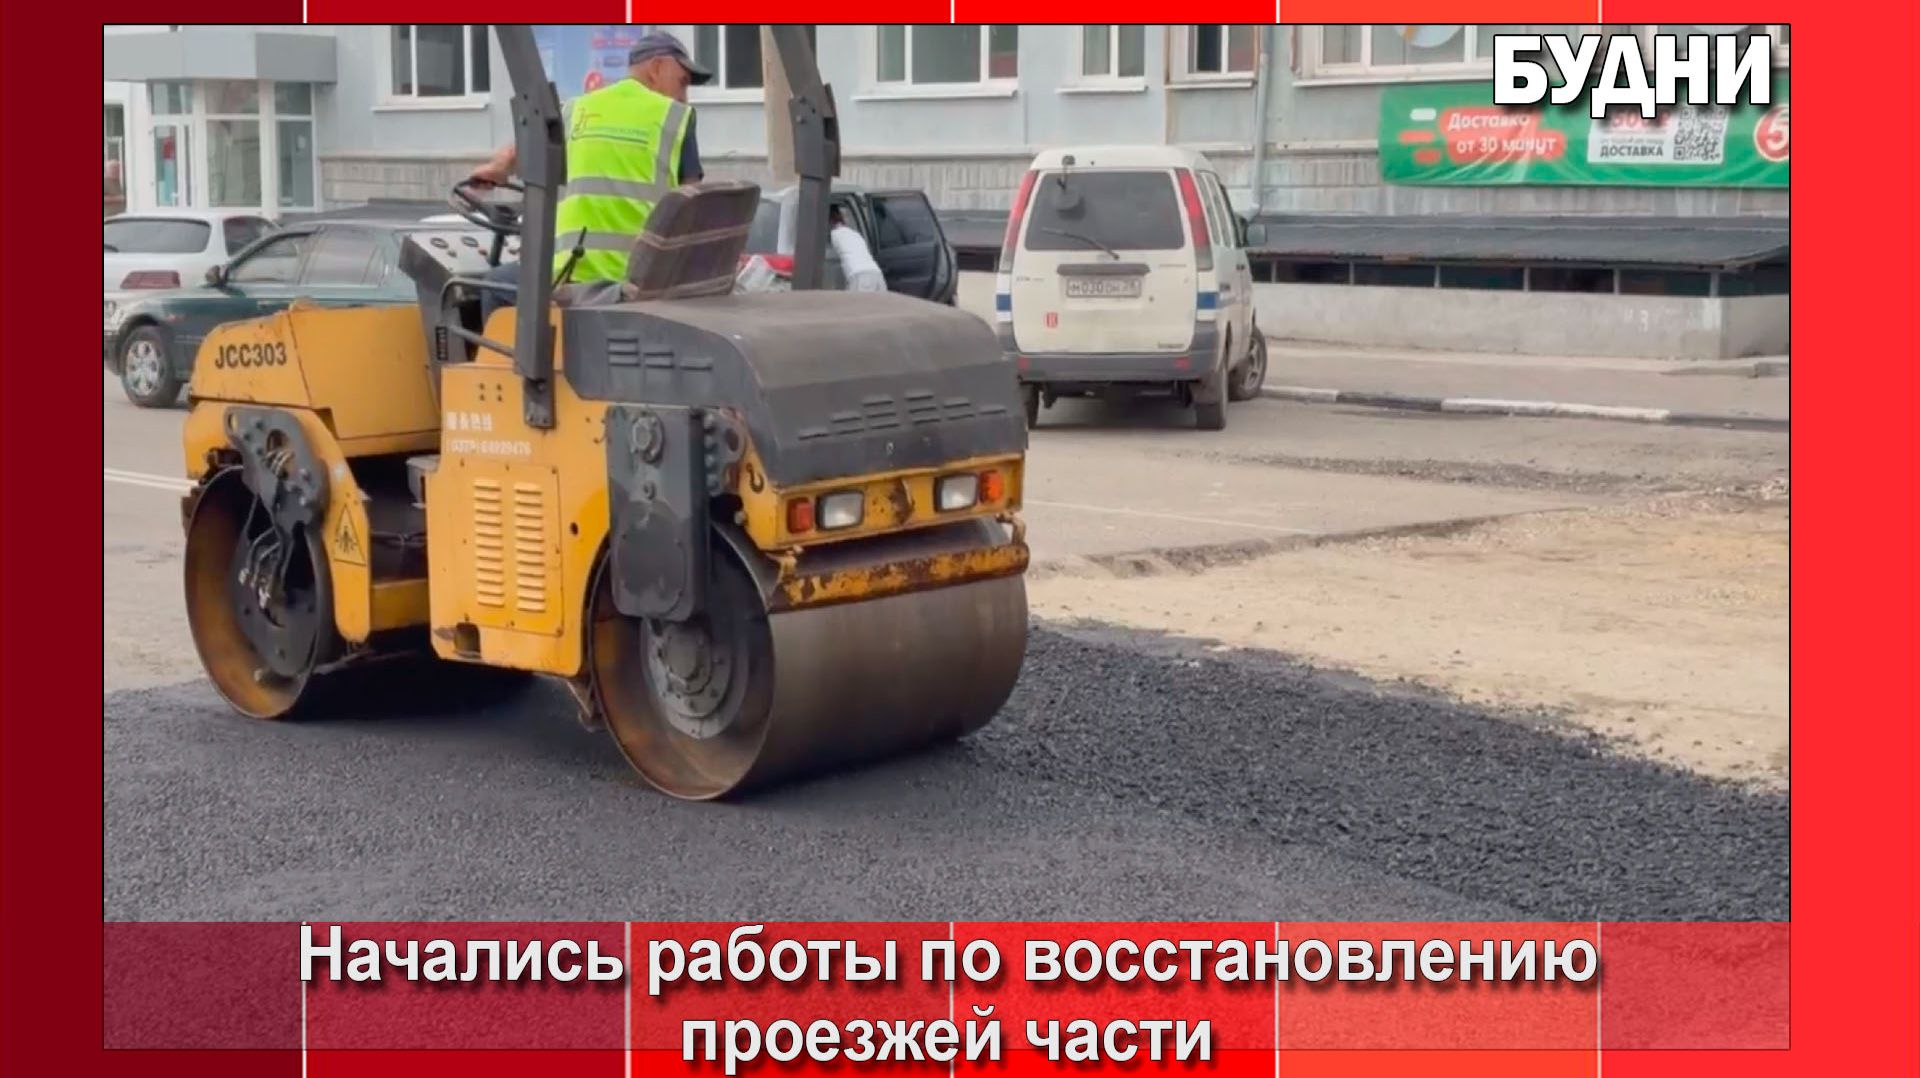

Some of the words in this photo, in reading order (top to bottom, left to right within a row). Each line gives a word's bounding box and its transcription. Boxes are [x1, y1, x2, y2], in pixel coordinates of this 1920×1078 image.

[1456, 139, 1475, 154] от
[1479, 136, 1498, 153] 30
[1502, 138, 1557, 155] минут
[1600, 144, 1664, 158] ДОСТАВКА
[214, 341, 287, 369] JCC303
